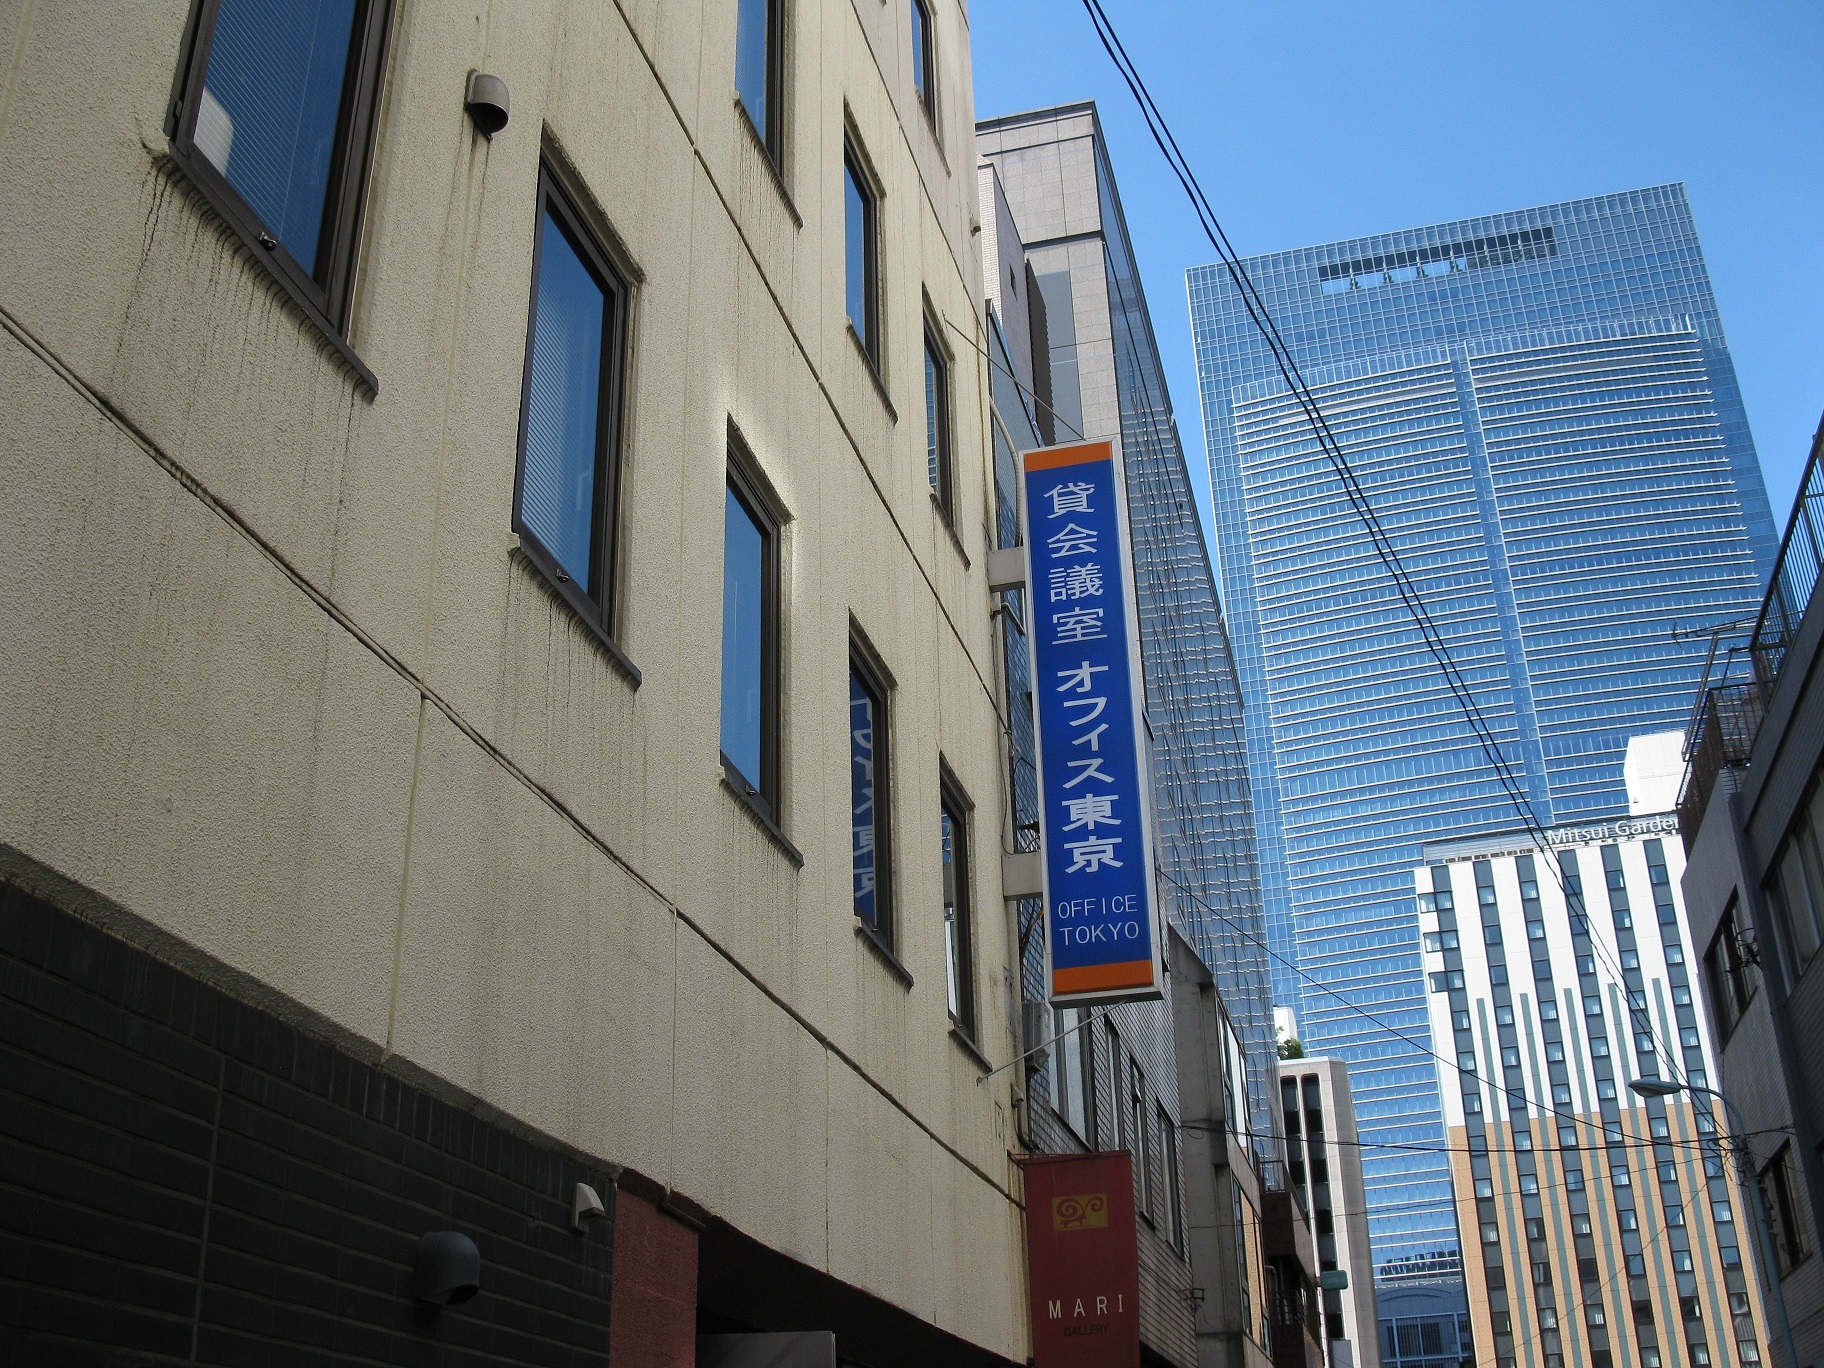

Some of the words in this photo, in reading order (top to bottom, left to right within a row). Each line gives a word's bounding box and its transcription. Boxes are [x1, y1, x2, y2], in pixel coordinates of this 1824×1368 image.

[1043, 481, 1108, 645] 貸会議室
[1056, 660, 1124, 874] オフィス東京
[1547, 822, 1610, 844] Mitsui
[1058, 894, 1138, 919] OFFICE
[1059, 921, 1139, 946] TOKYO
[1048, 1294, 1124, 1319] MARI
[1063, 1323, 1109, 1337] GALLERY
